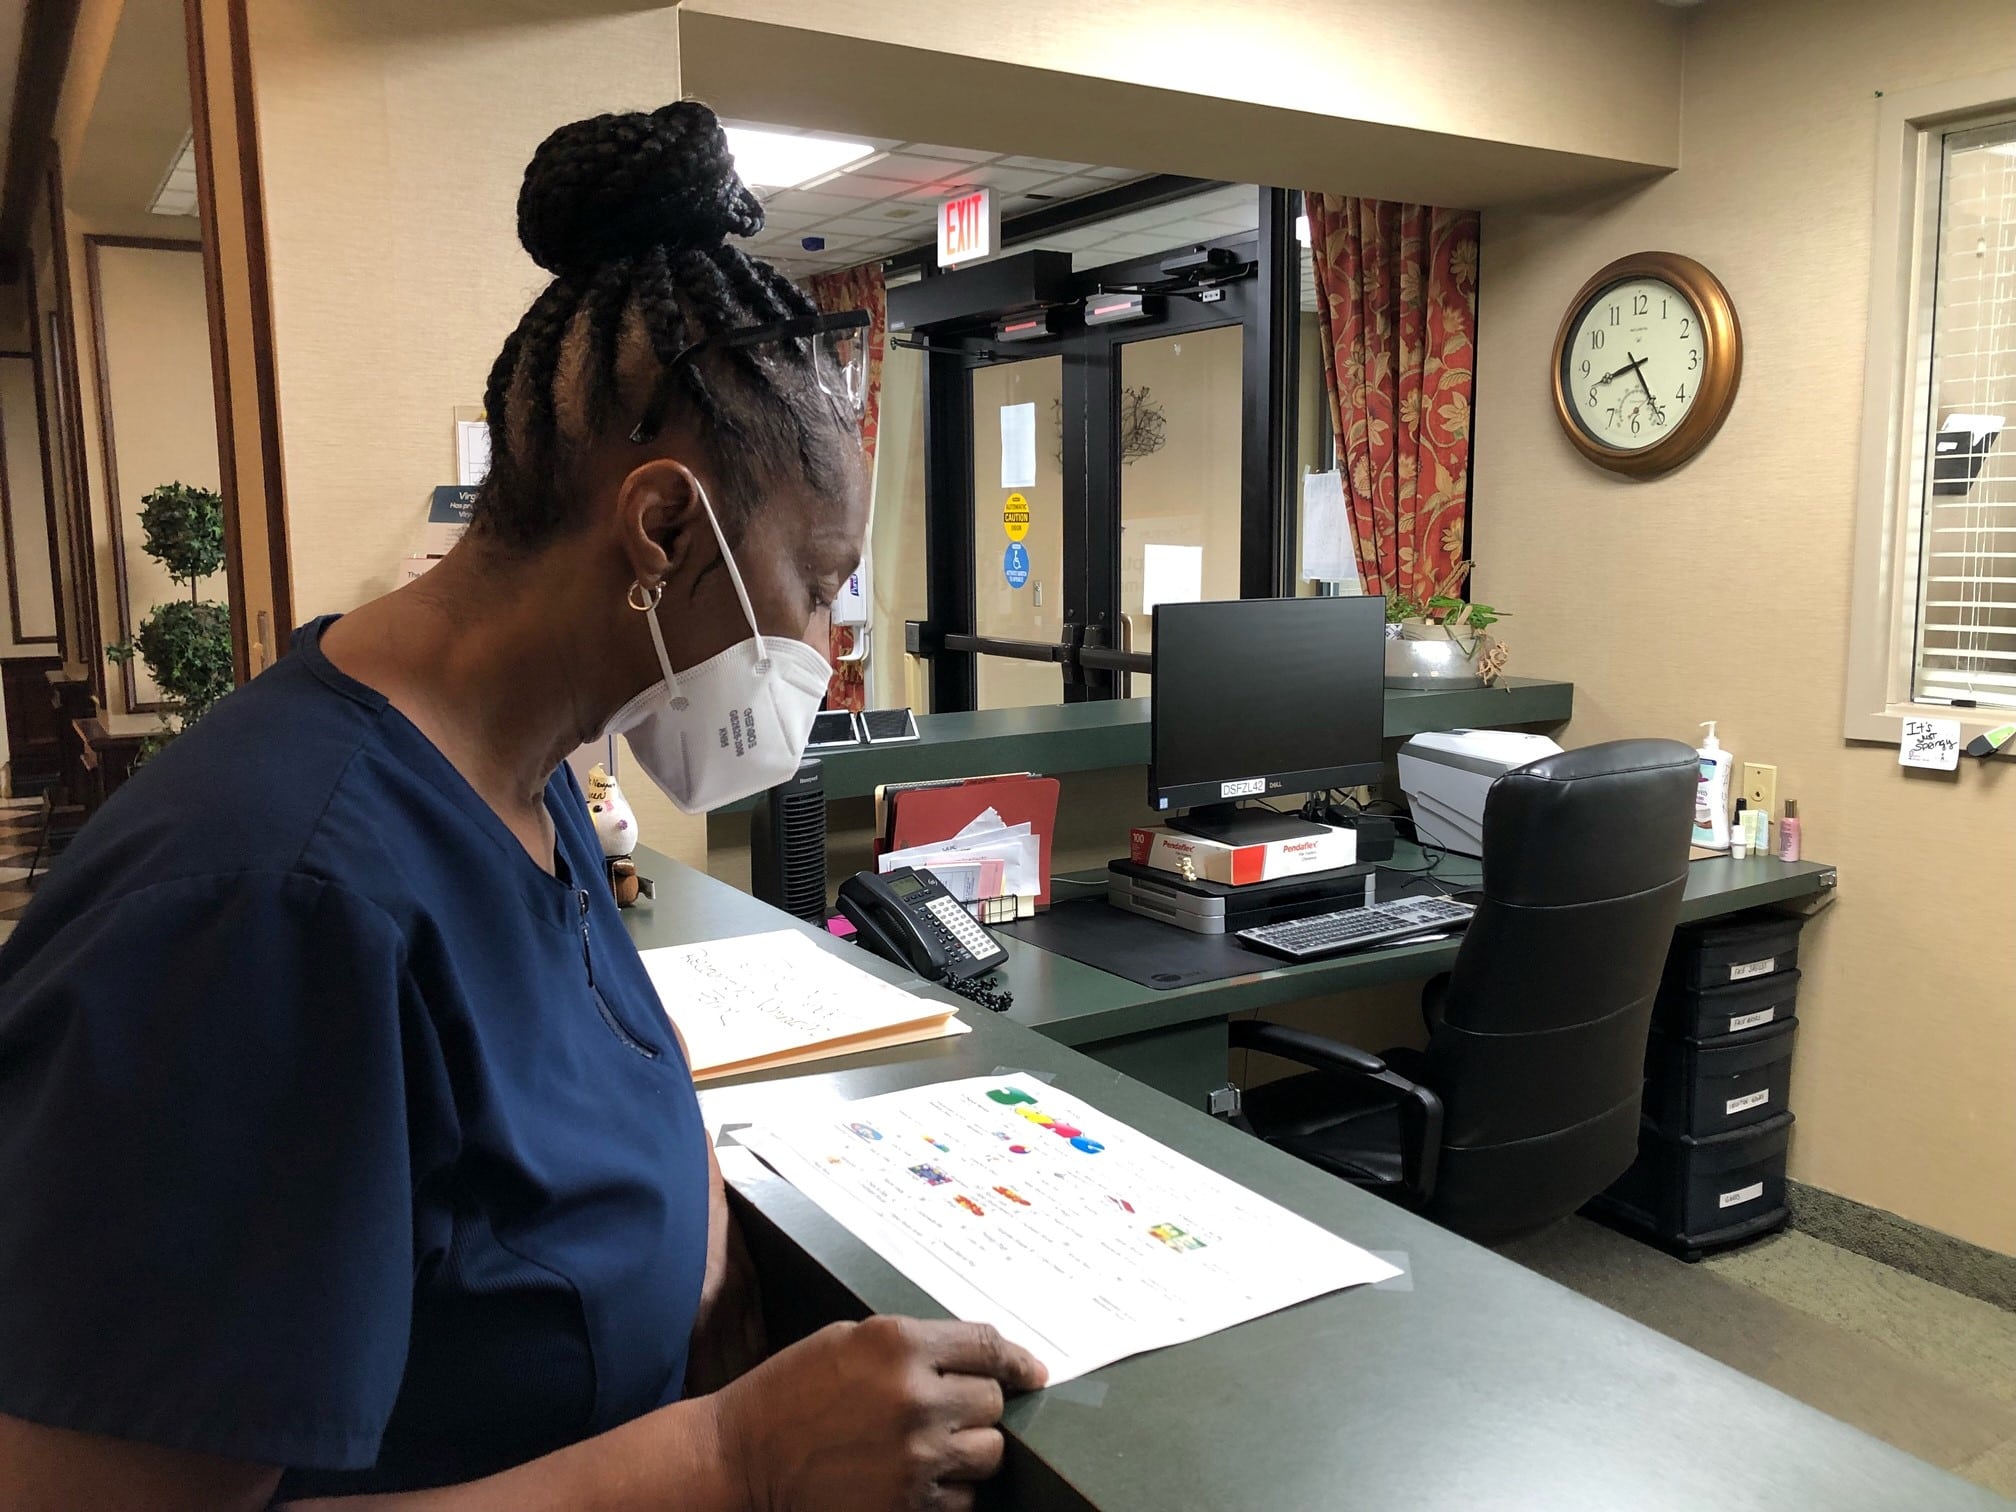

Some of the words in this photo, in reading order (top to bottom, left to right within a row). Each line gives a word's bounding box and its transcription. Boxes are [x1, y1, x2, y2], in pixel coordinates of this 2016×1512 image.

[946, 193, 982, 255] EXIT
[1633, 295, 1648, 316] 12
[1661, 299, 1667, 319] 1
[1609, 306, 1620, 326] 11
[1680, 318, 1689, 339] 2
[1591, 330, 1605, 350] 10
[1581, 359, 1590, 379] 9
[1688, 350, 1697, 370] 3
[1588, 387, 1598, 407] 8
[1675, 383, 1685, 403] 4
[1606, 407, 1615, 428] 7
[1631, 413, 1640, 434] 6
[1656, 405, 1666, 426] 5
[1004, 513, 1028, 522] CAUTION
[1906, 721, 1933, 736] It's
[1223, 780, 1264, 796] DSFZL42
[1269, 781, 1283, 789] DELL
[1132, 832, 1145, 844] 100
